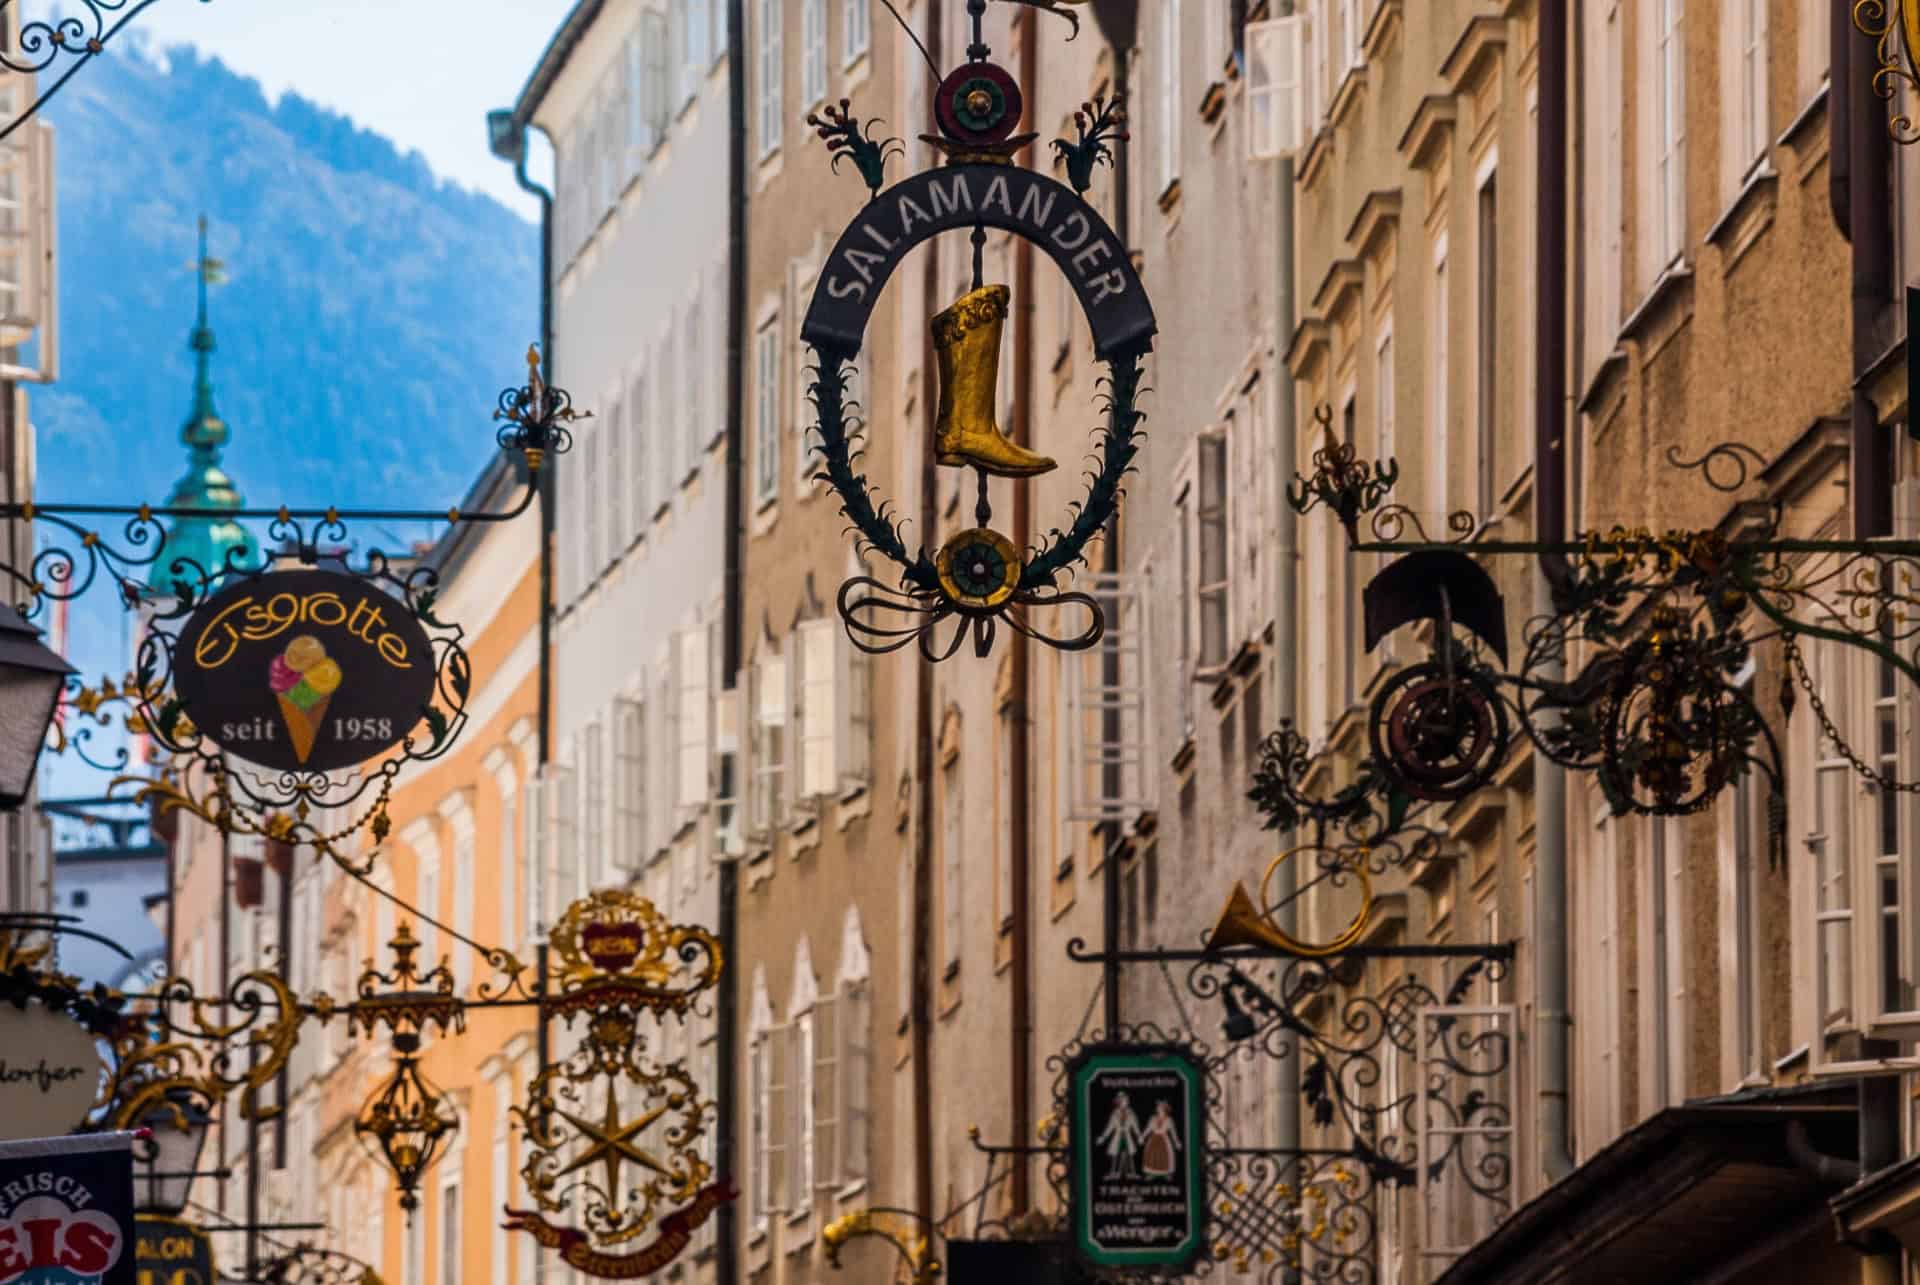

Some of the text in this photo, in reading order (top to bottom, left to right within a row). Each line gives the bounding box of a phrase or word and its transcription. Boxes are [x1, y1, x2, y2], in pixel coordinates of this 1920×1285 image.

[827, 173, 1127, 306] SALAMANDER
[195, 592, 413, 669] Eisgrotte
[221, 717, 393, 741] seit 1958
